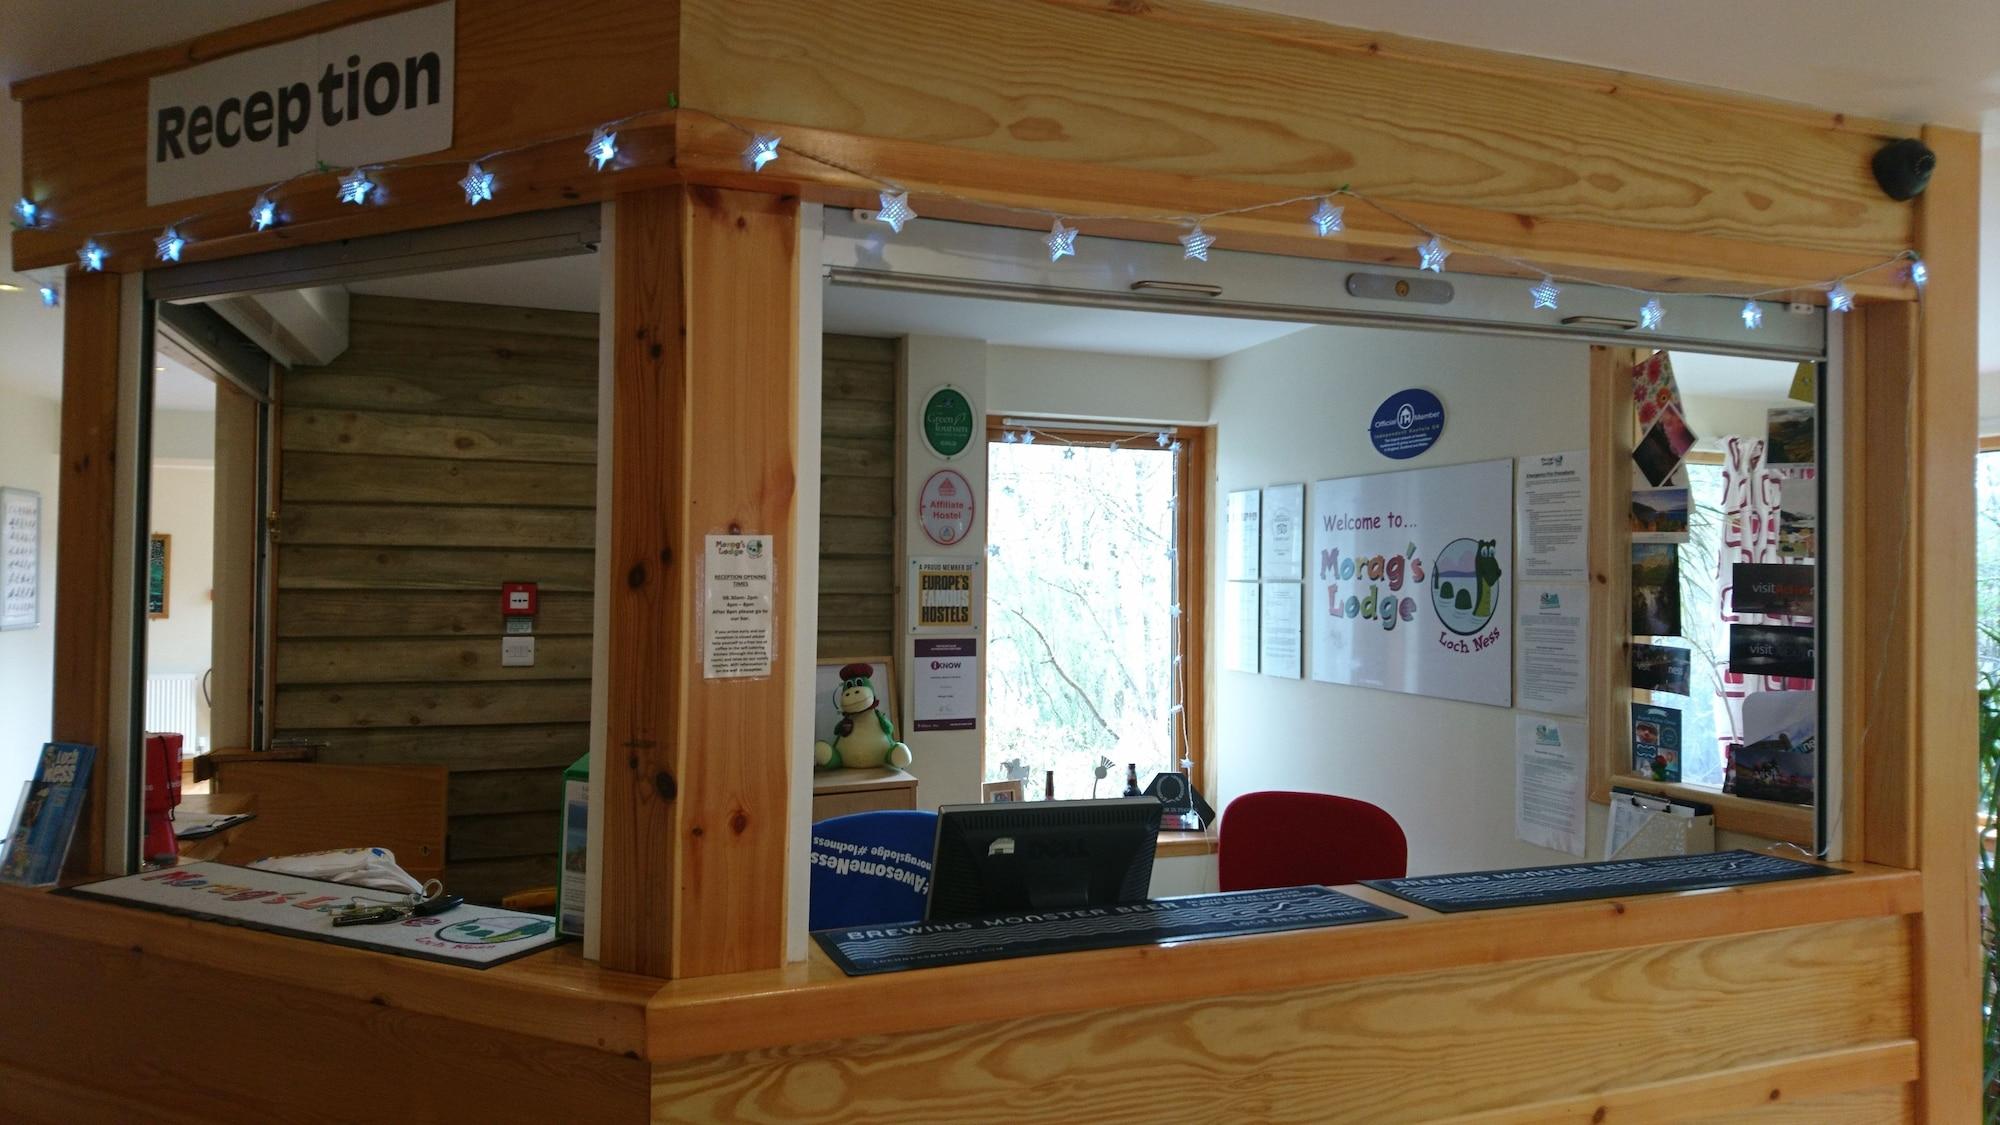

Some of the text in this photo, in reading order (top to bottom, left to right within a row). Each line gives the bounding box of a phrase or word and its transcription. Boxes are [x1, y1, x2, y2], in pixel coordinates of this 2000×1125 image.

[156, 51, 440, 163] Reception
[1375, 418, 1396, 429] Official
[930, 501, 964, 509] Affiliate
[933, 511, 961, 519] Hostel
[1323, 512, 1417, 531] Welcome to...
[1320, 541, 1425, 592] Morag's
[922, 574, 969, 591] EUROPE'S
[1752, 583, 1775, 594] visit
[922, 590, 969, 607] FAMOUS
[1327, 583, 1417, 631] Lodge
[922, 606, 969, 623] HOSTELS
[1439, 627, 1500, 653] Loch Ness
[1750, 645, 1773, 655] visit
[813, 836, 869, 856] #lochness
[1390, 862, 1648, 889] BREWING MONSTER BEER
[846, 901, 1180, 941] BREWING MONSTER BEER
